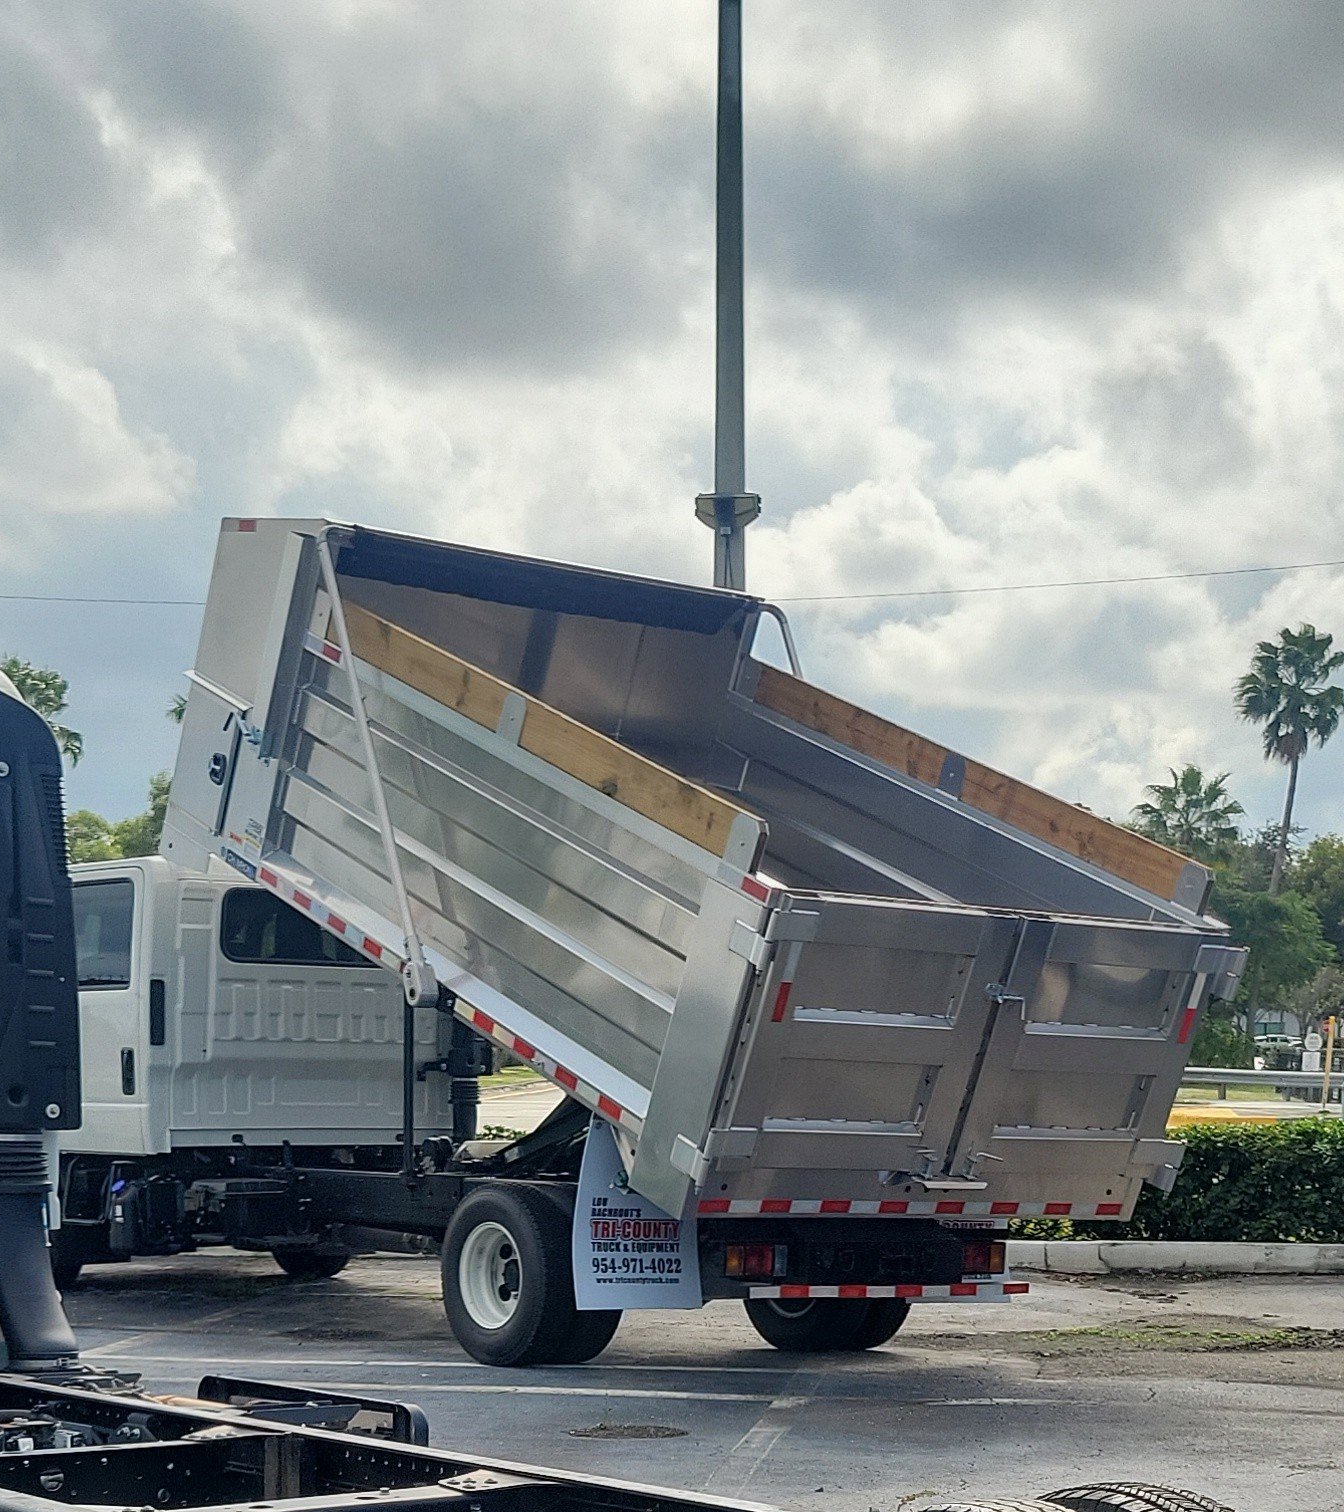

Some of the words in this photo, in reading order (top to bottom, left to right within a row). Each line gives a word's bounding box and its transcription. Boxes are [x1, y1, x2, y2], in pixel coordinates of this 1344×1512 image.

[591, 1219, 681, 1240] TRI-COUNTY
[591, 1242, 621, 1253] TRUCK
[632, 1242, 680, 1254] EQUIPMENT
[591, 1257, 682, 1274] 954-971-4022
